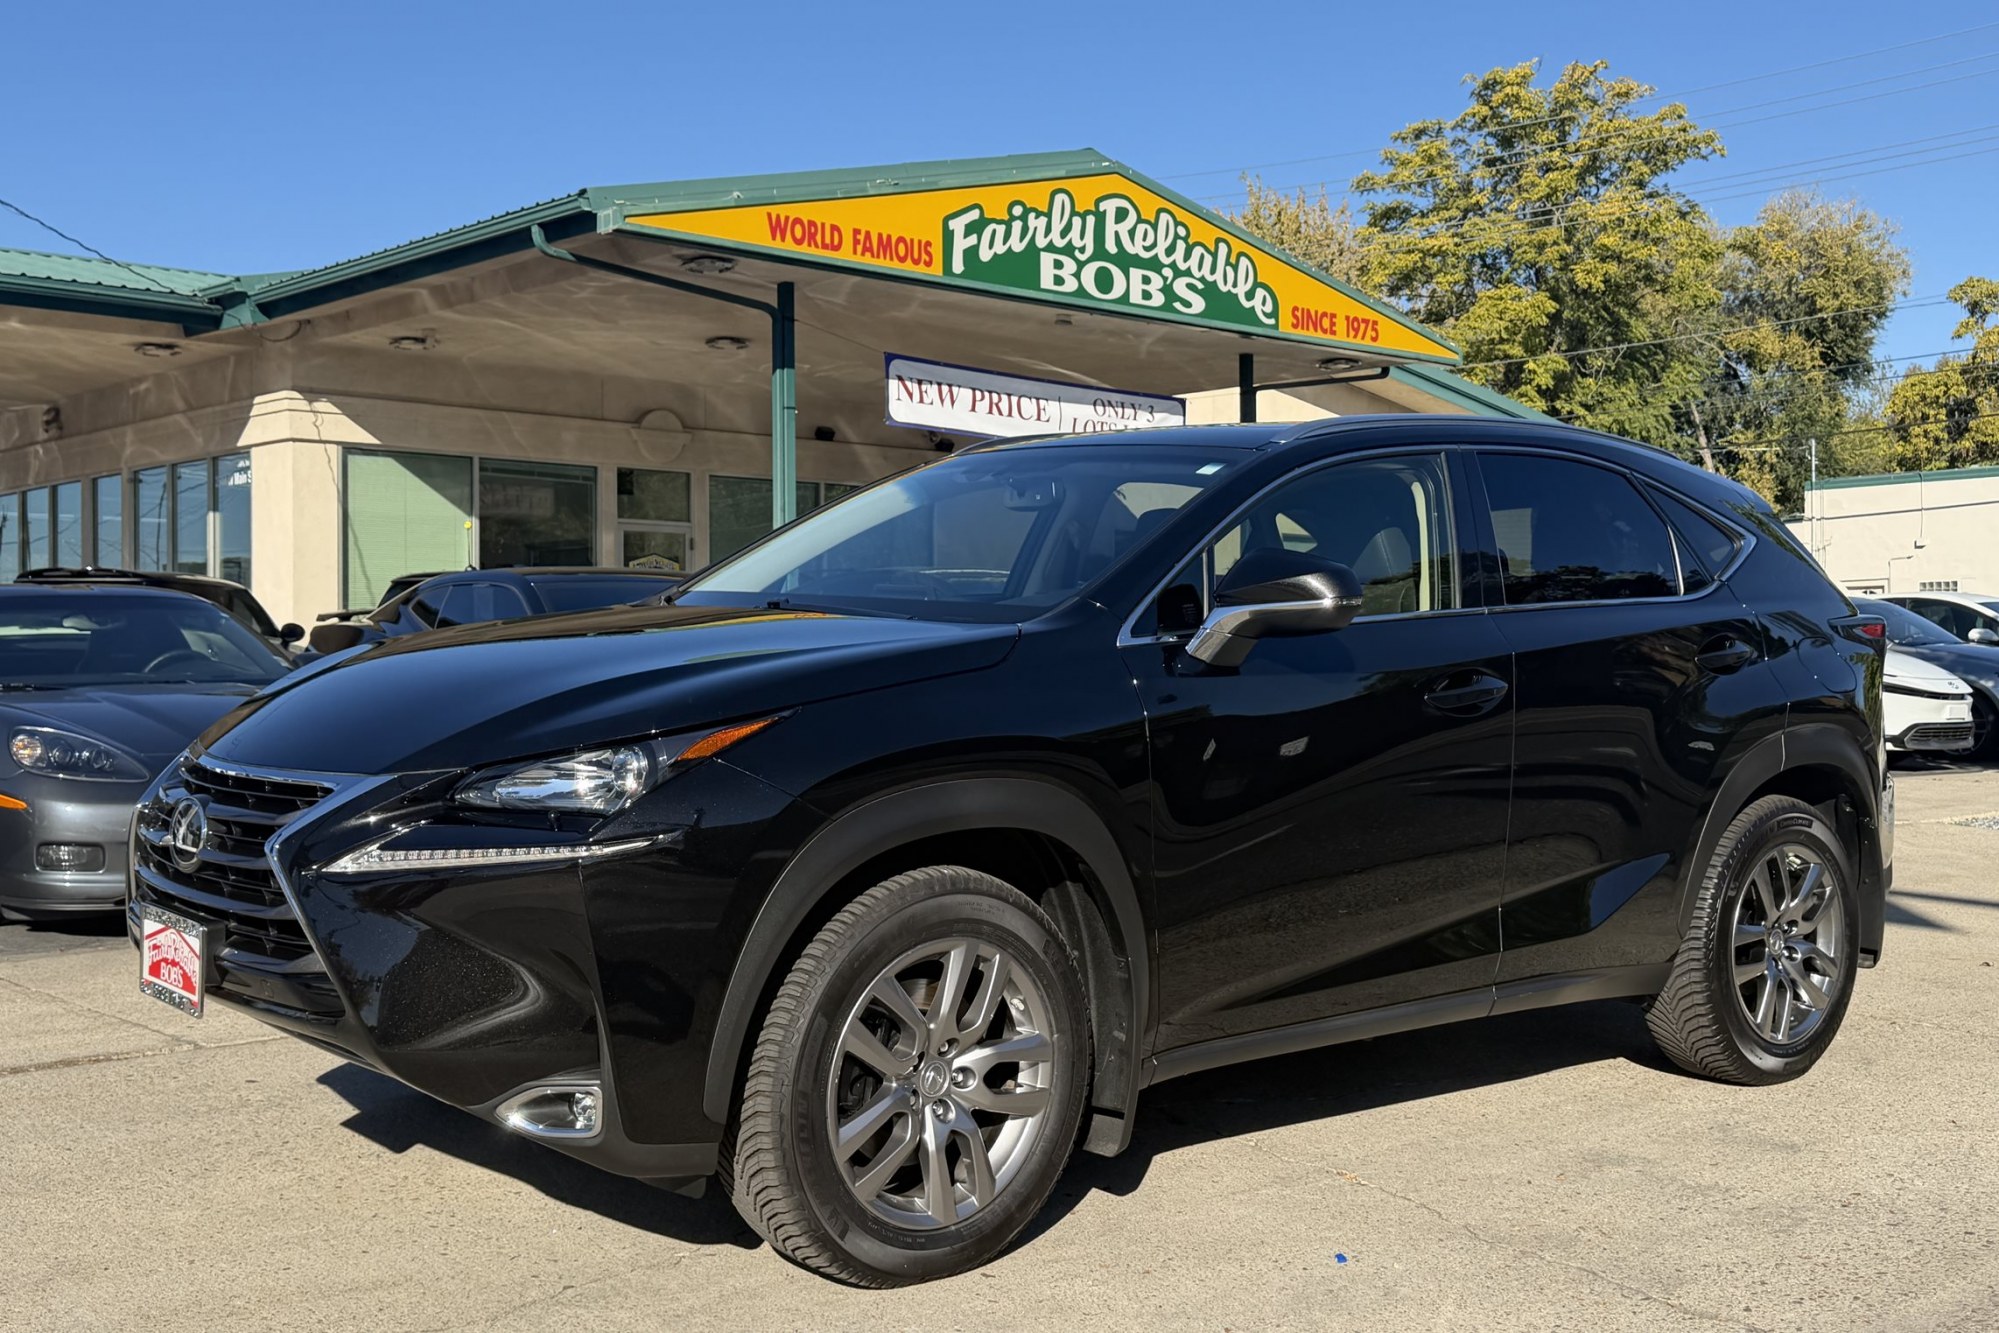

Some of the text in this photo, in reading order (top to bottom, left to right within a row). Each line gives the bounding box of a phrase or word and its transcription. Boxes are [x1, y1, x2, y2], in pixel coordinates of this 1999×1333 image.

[766, 211, 934, 268] WORLD FAMOUS
[948, 193, 1276, 325] Fairly Reliable
[1040, 250, 1206, 315] BOB'S
[1291, 305, 1379, 343] SINCE 1975
[895, 374, 1051, 422] NEW PRICE
[1093, 397, 1155, 423] ONLY 3
